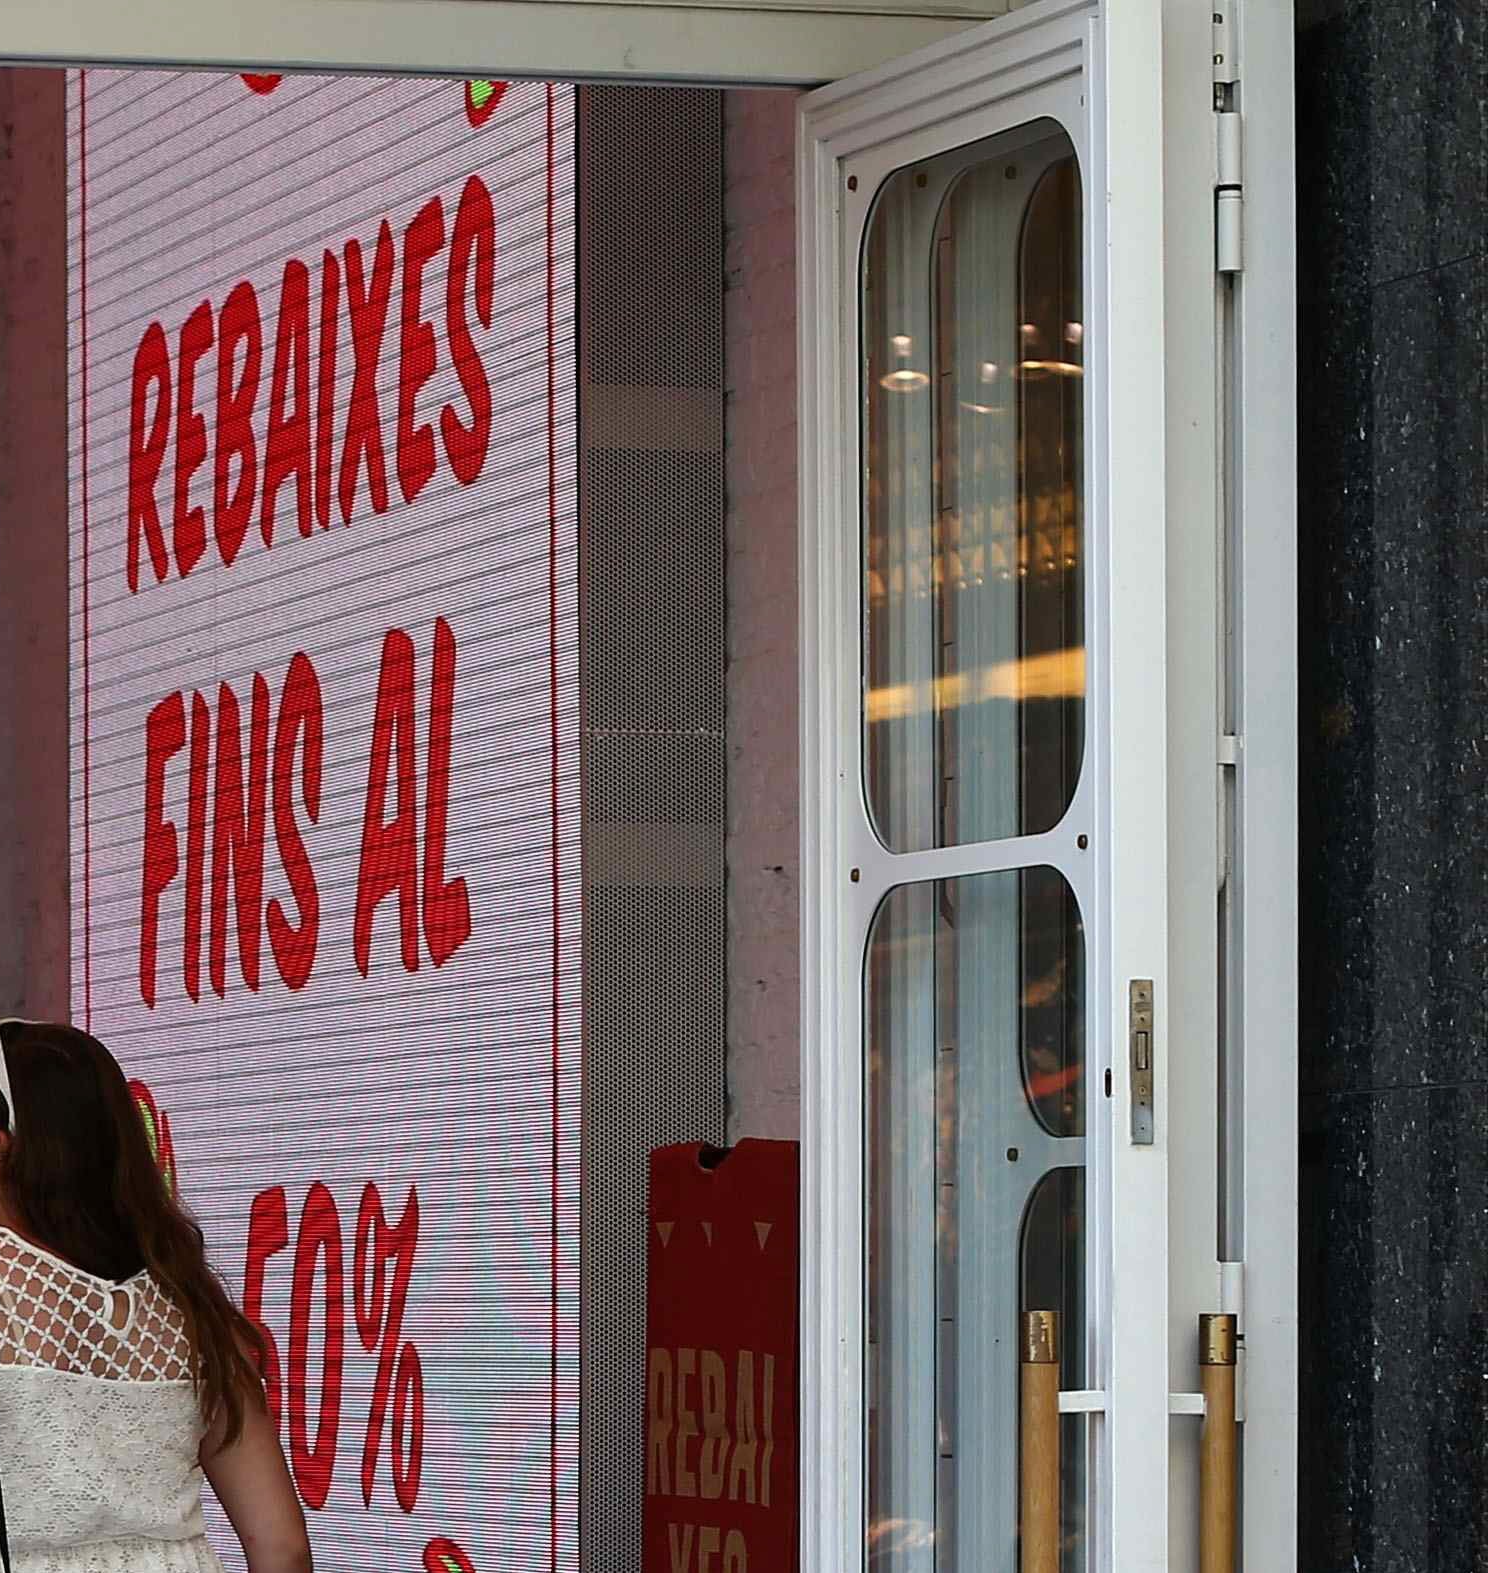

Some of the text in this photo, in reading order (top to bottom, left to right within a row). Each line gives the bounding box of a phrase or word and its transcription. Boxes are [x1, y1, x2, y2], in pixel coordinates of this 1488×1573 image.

[127, 174, 496, 594] REBAIXES
[140, 615, 472, 1010] FINS AL
[242, 1180, 423, 1514] 50%
[647, 1346, 774, 1509] REBAI
